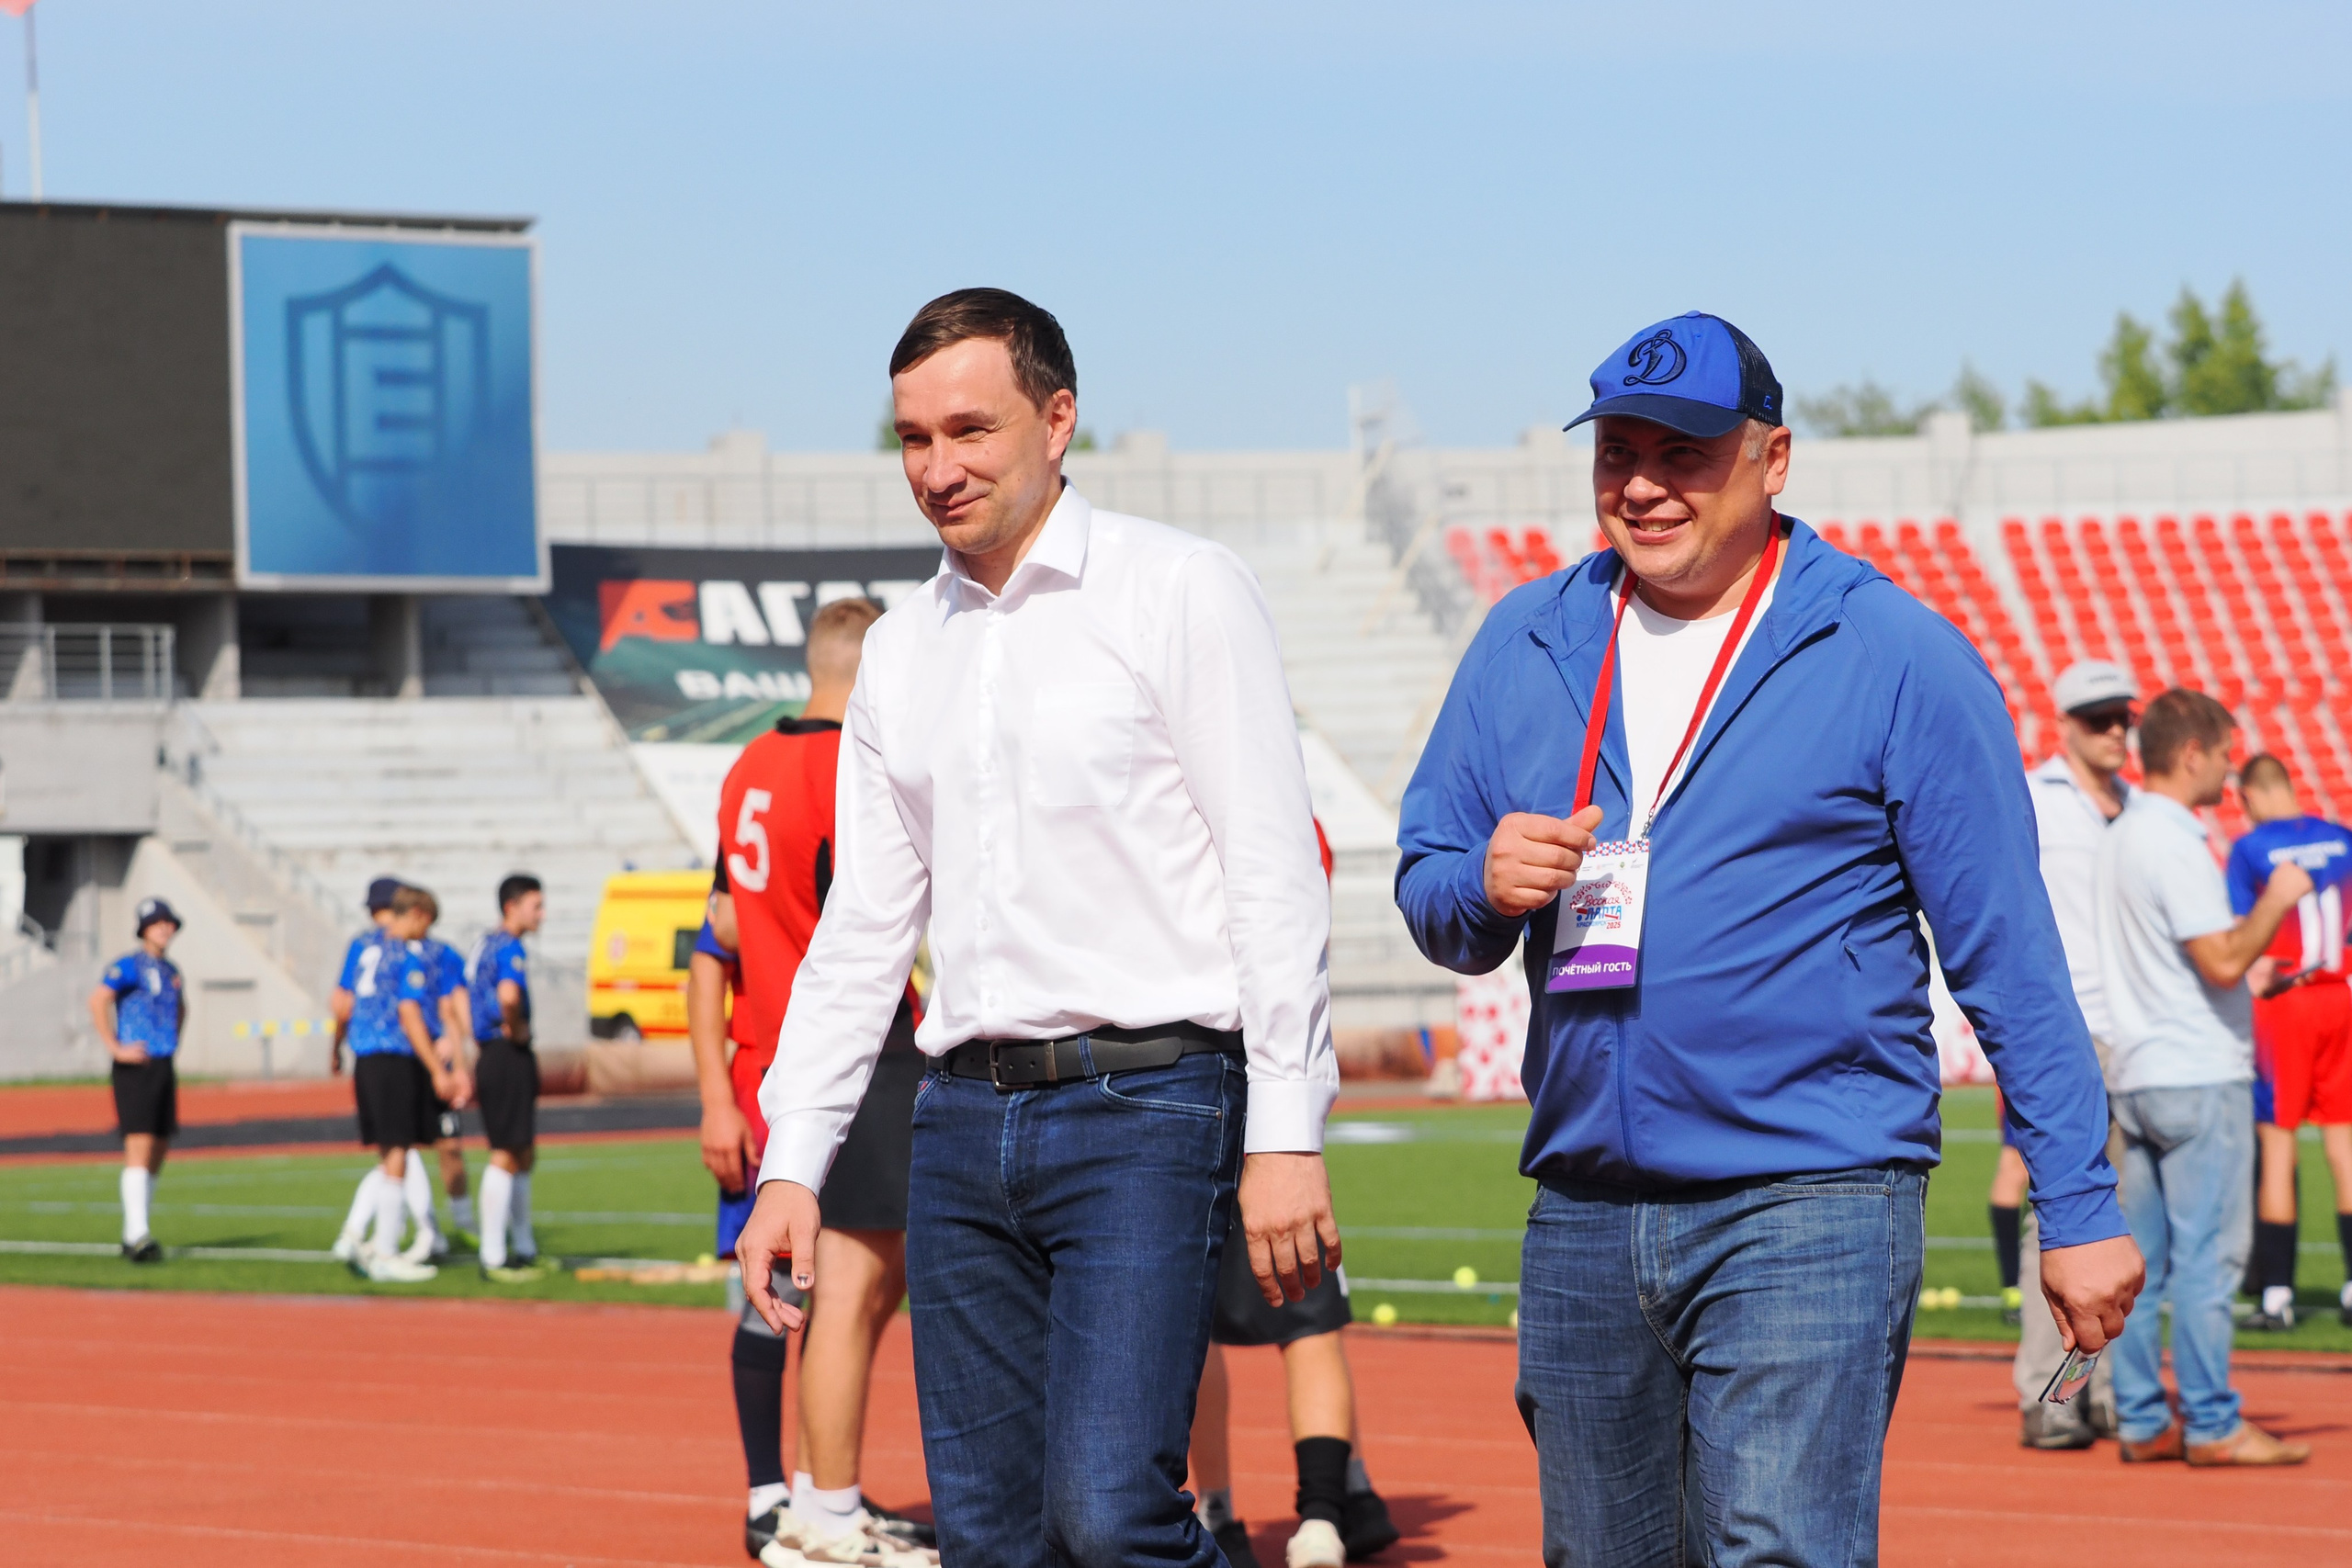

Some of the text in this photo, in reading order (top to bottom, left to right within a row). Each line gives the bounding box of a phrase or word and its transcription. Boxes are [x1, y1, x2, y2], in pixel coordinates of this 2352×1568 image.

[728, 787, 773, 893] 5
[1585, 905, 1622, 920] ЛАПТА
[2298, 884, 2342, 973] 11
[1552, 962, 1632, 976] ПОЧЁТНЫЙ ГОСТЬ
